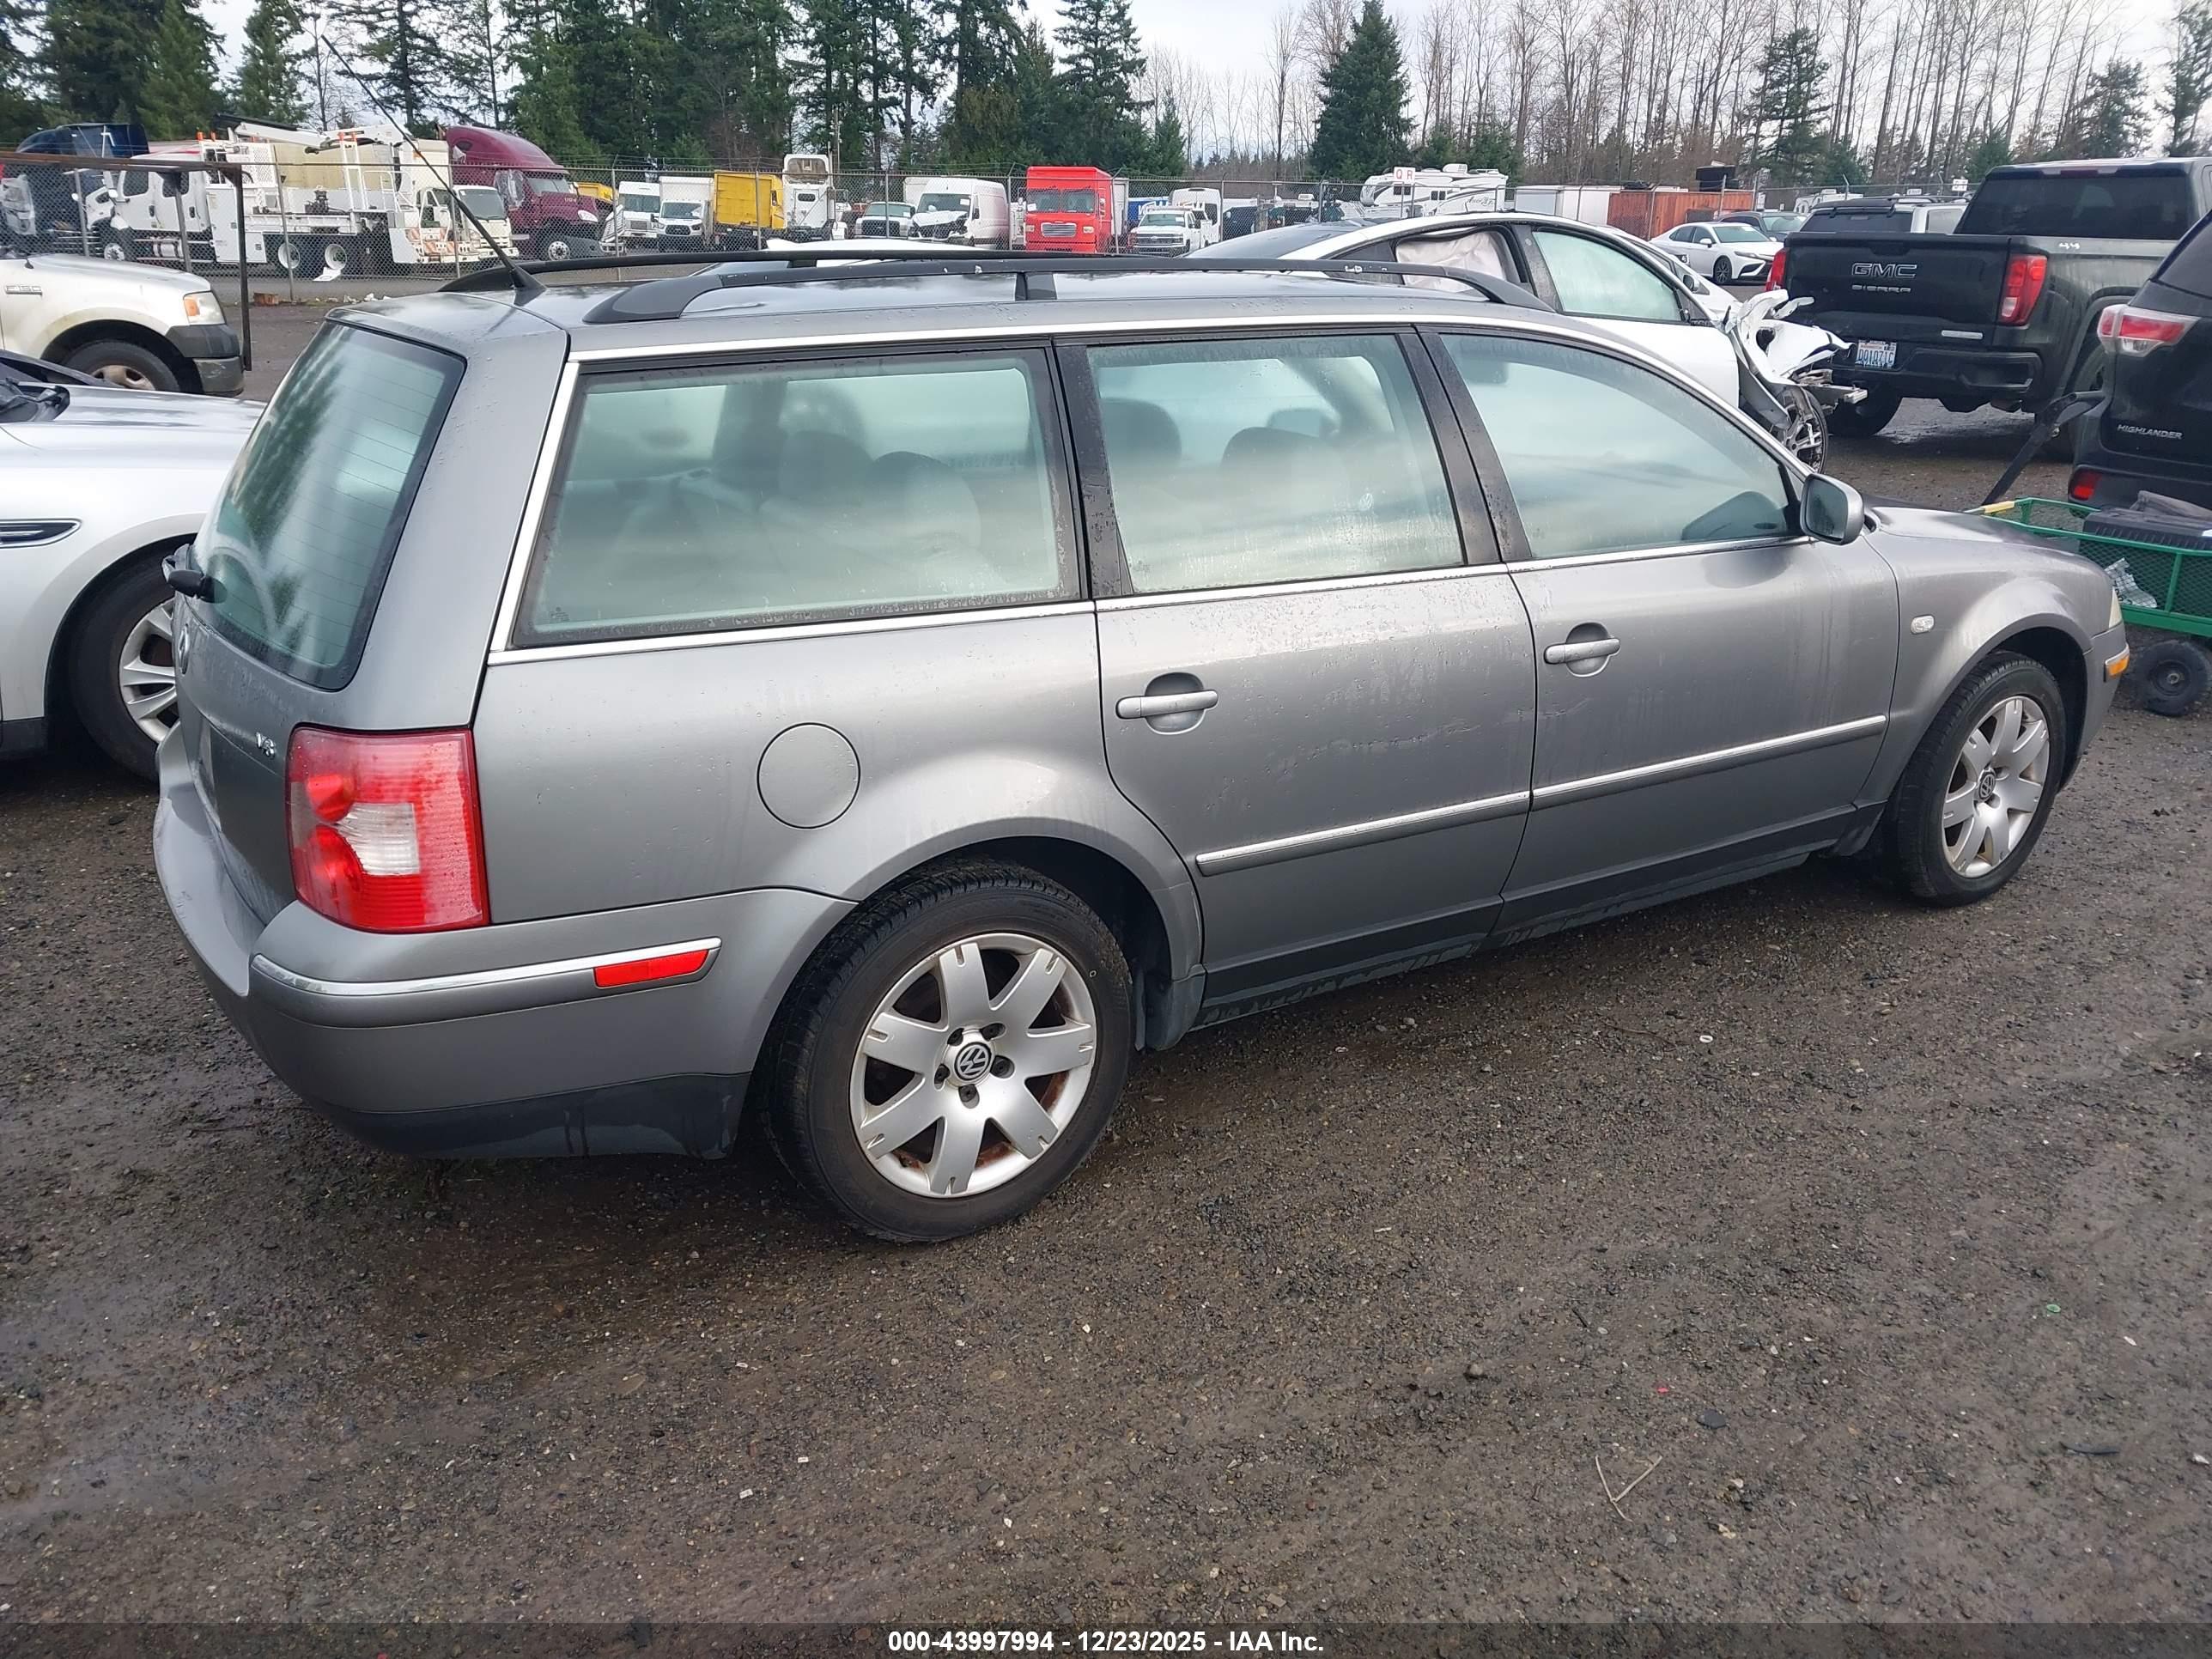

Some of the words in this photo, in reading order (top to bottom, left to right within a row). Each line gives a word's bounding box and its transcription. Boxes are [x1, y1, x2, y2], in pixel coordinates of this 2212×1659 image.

[1396, 169, 1402, 179] Q
[1851, 263, 1917, 279] GMC
[1851, 284, 1911, 293] SIERRA
[2117, 424, 2183, 440] HIGHLANDER
